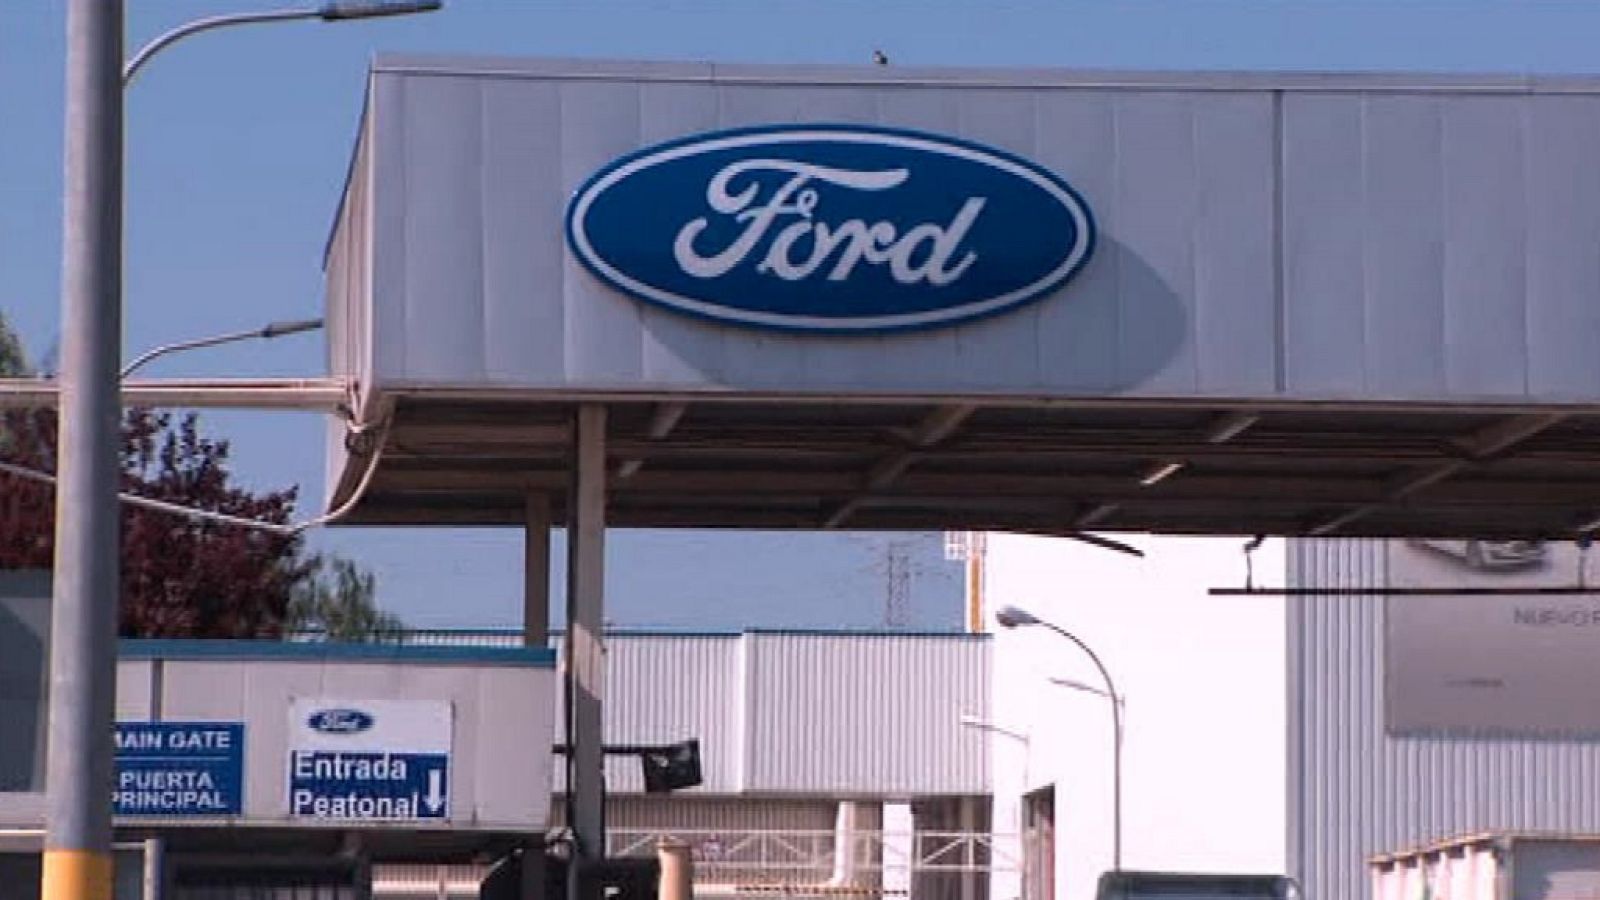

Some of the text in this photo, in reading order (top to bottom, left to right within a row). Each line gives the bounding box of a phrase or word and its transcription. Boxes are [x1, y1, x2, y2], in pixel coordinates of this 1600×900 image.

[673, 157, 987, 285] Ford
[168, 730, 231, 748] GATE
[295, 751, 407, 780] Entrada
[120, 771, 215, 790] PUERTA
[294, 789, 419, 819] Peatonal
